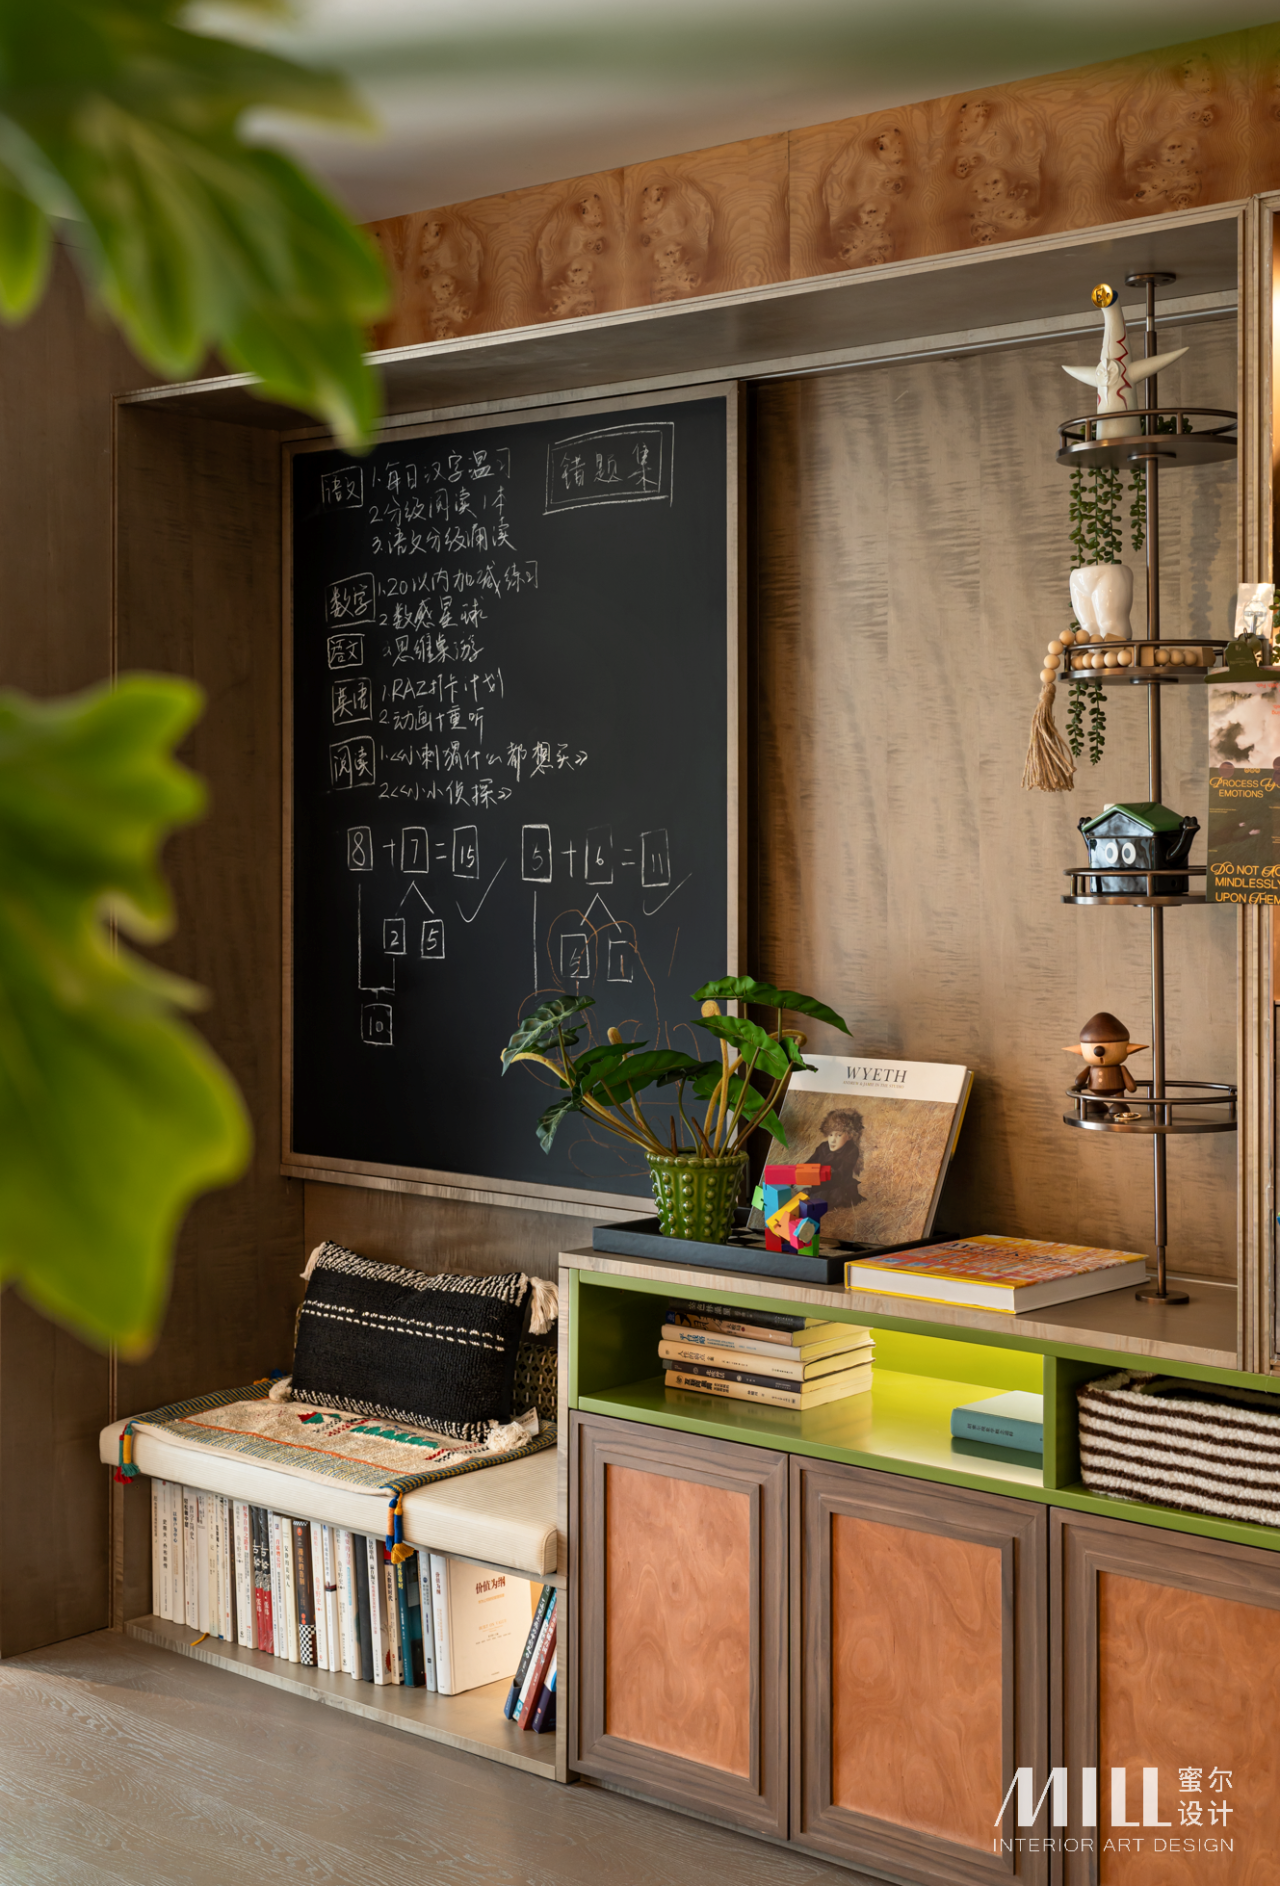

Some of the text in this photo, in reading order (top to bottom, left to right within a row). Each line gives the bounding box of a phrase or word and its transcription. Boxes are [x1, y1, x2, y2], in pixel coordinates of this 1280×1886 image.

[560, 442, 658, 492] 错题集
[325, 475, 361, 504] 语文
[330, 583, 373, 618] 数学
[330, 638, 359, 663] 语文
[334, 682, 368, 717] 英语
[333, 745, 374, 783] 阅读
[1209, 776, 1259, 788] PROCESS
[1218, 789, 1264, 798] EMOTIONS
[1210, 861, 1235, 875] DO
[1236, 865, 1260, 875] NOT
[1215, 892, 1247, 903] UPON
[847, 1065, 908, 1083] WYETH
[475, 1575, 506, 1594] 价值为纲
